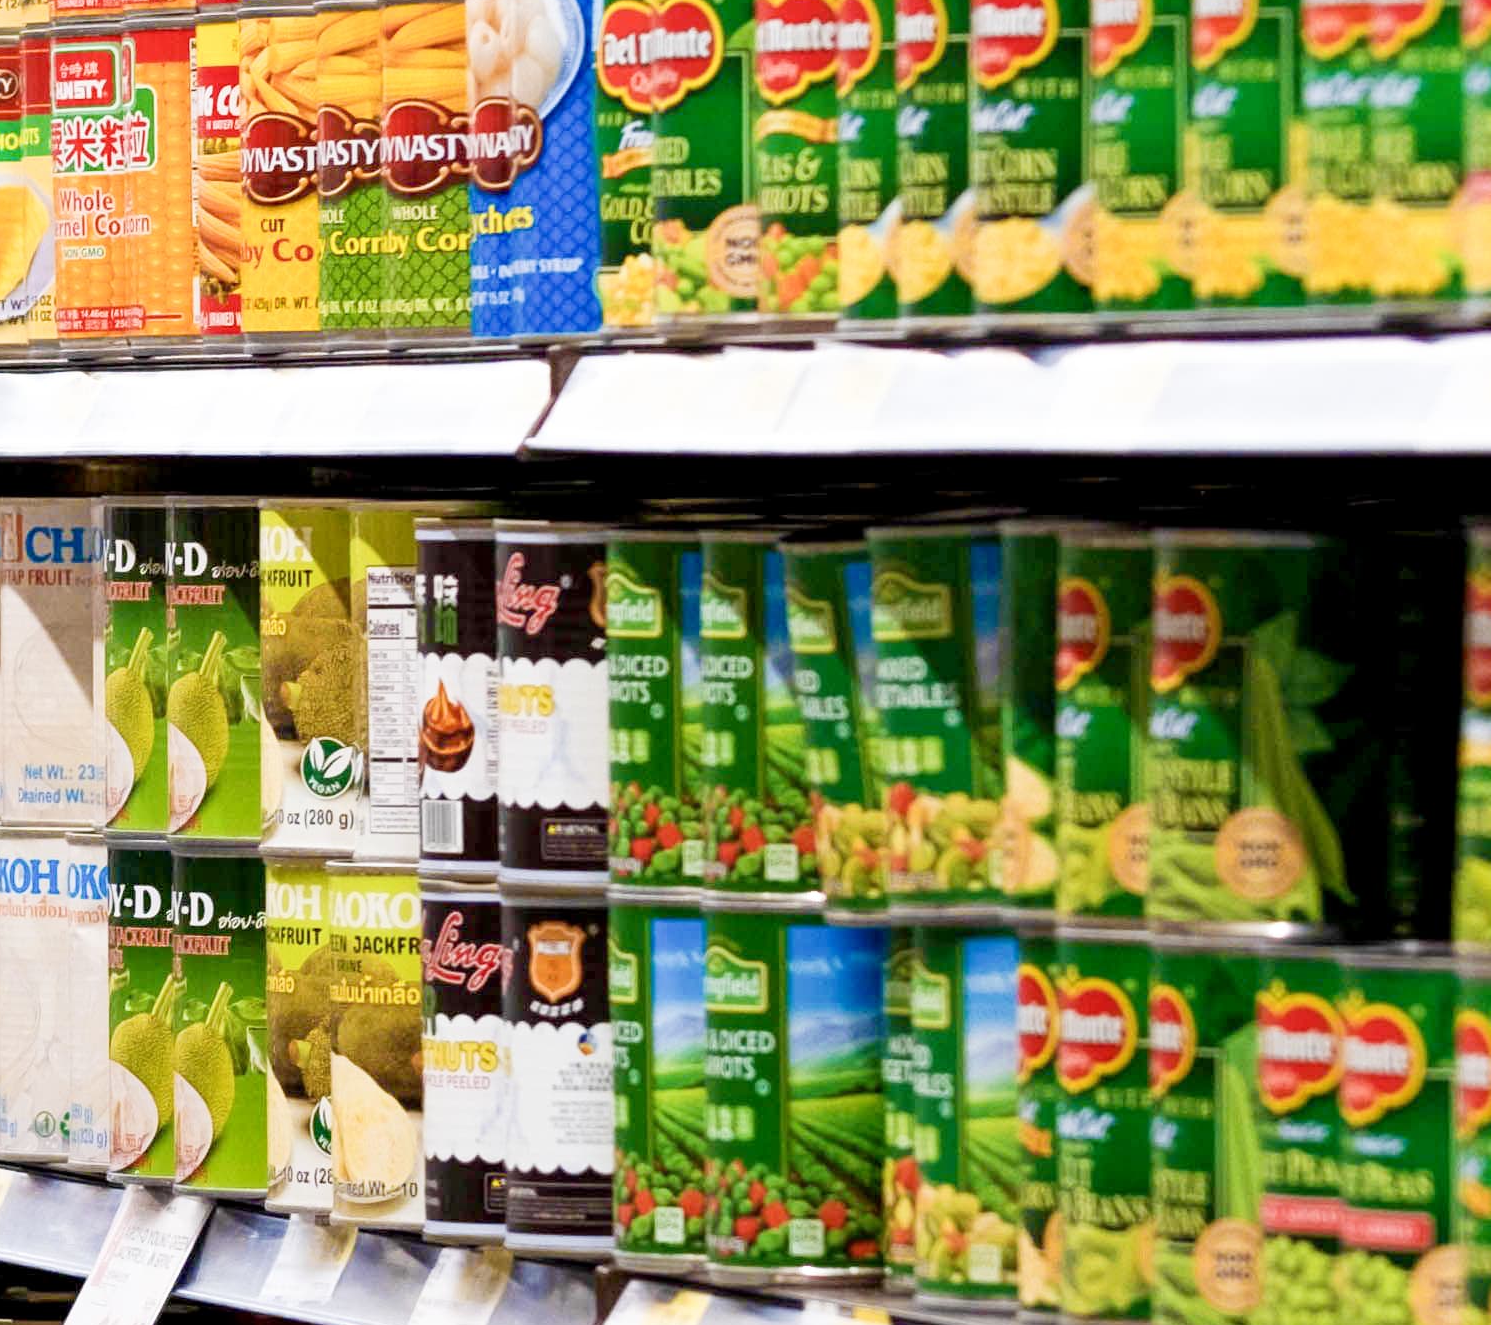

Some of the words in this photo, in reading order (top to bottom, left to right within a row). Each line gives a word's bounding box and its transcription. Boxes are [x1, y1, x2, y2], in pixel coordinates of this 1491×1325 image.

[241, 146, 319, 174] DYNAST
[320, 138, 380, 168] NASTY
[59, 188, 115, 212] Whole
[393, 204, 439, 222] WHOLE
[260, 217, 285, 233] CUT
[416, 225, 469, 254] Cor
[307, 776, 341, 796] VEGAN
[352, 934, 421, 955] JACKFR
